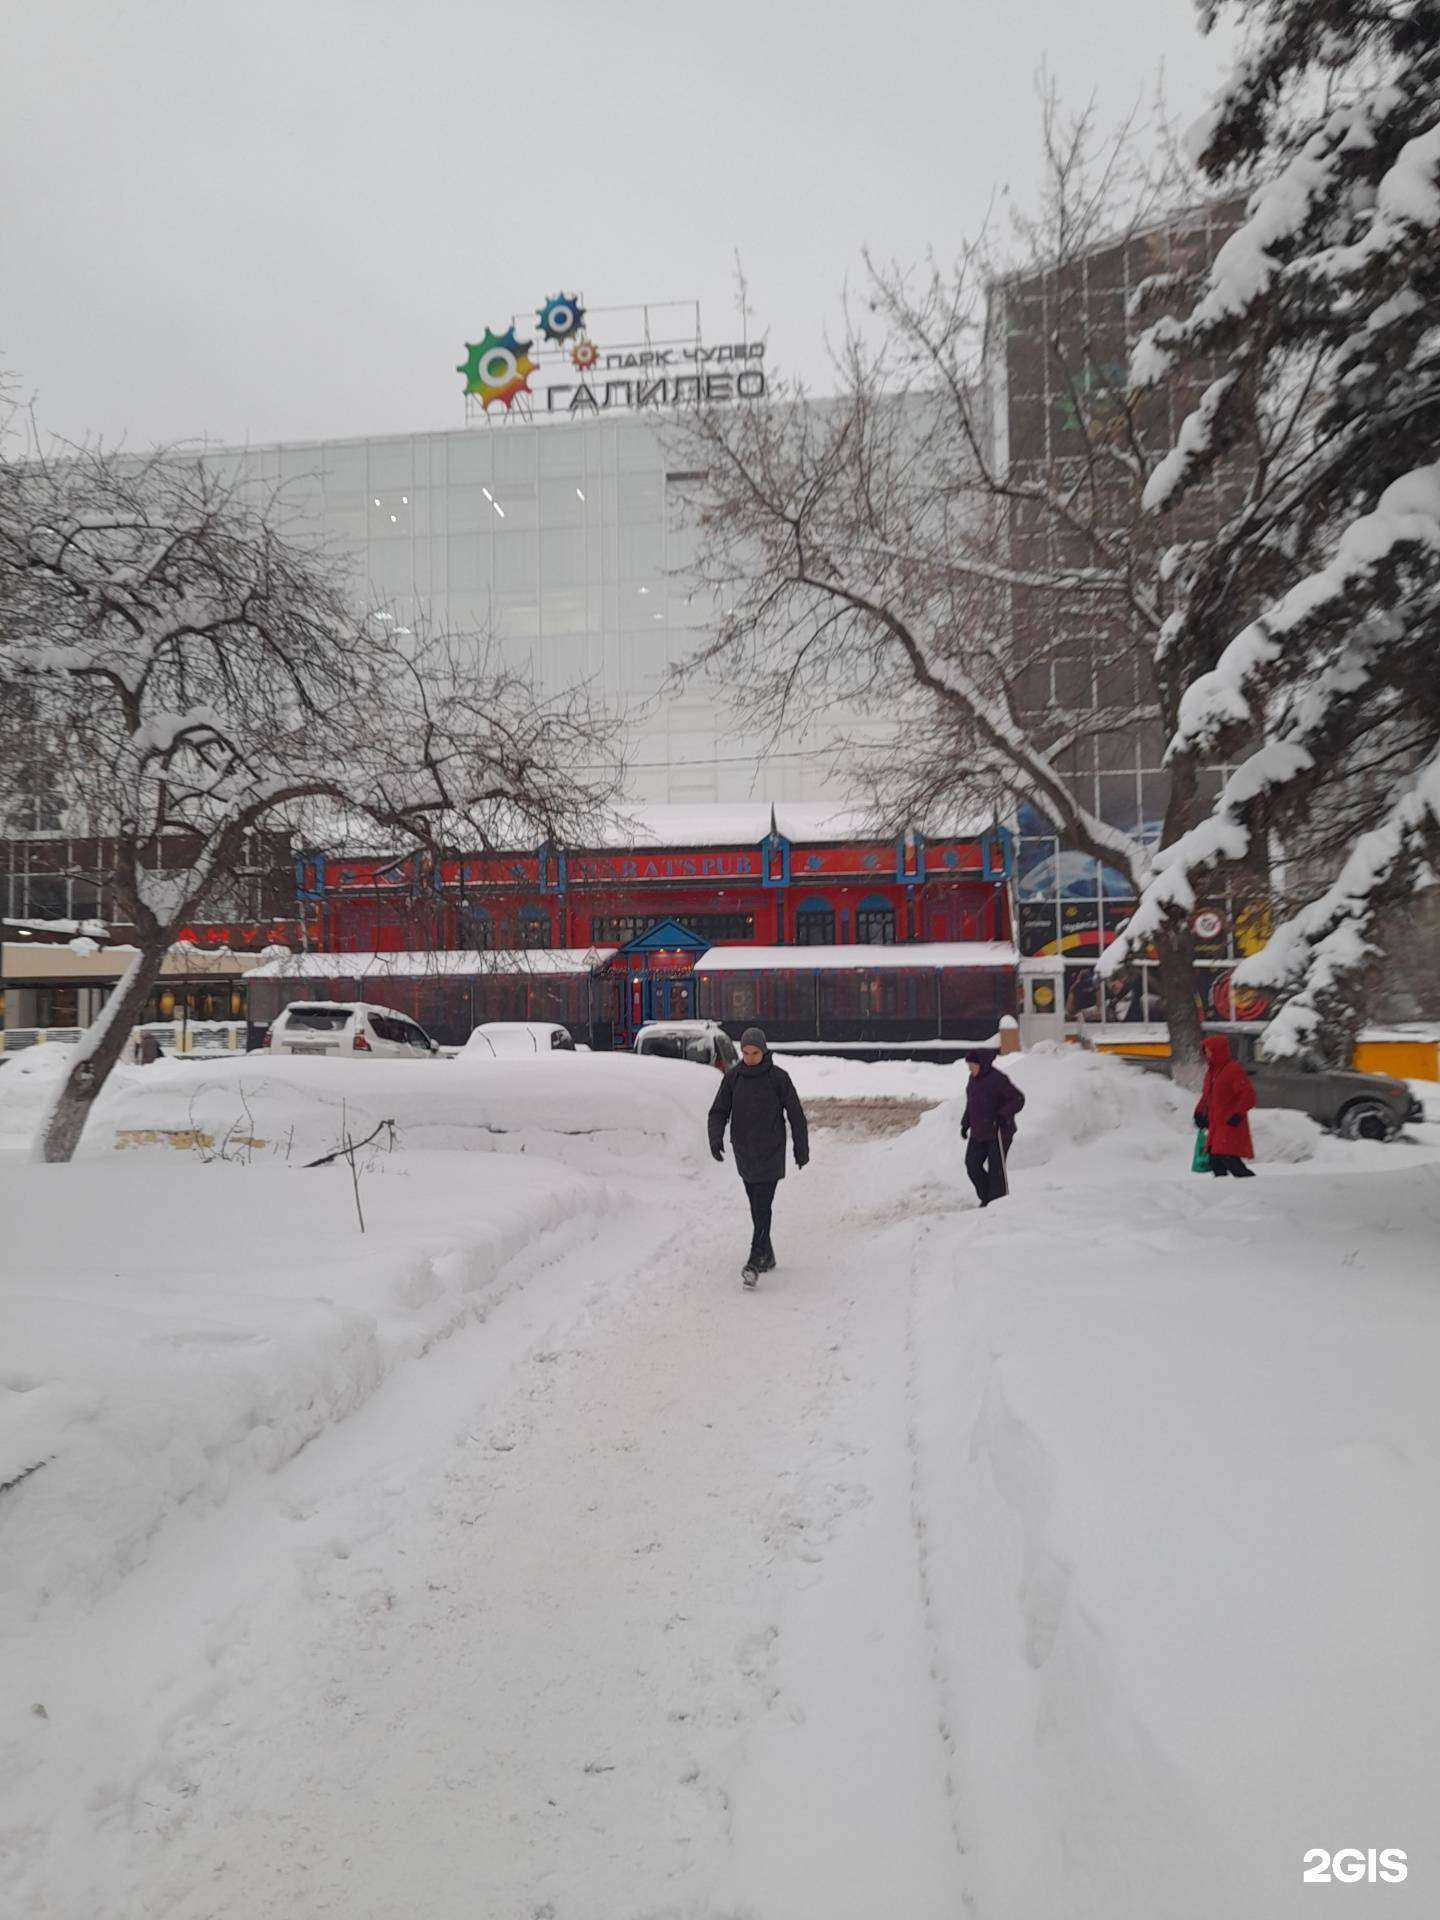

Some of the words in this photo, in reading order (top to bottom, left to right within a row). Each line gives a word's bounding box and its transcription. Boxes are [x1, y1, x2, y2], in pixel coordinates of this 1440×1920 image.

[606, 350, 674, 370] ПАРК
[682, 343, 765, 364] ЧУДЕС
[547, 371, 765, 410] ГАЛИЛЕО
[702, 857, 751, 876] PUB
